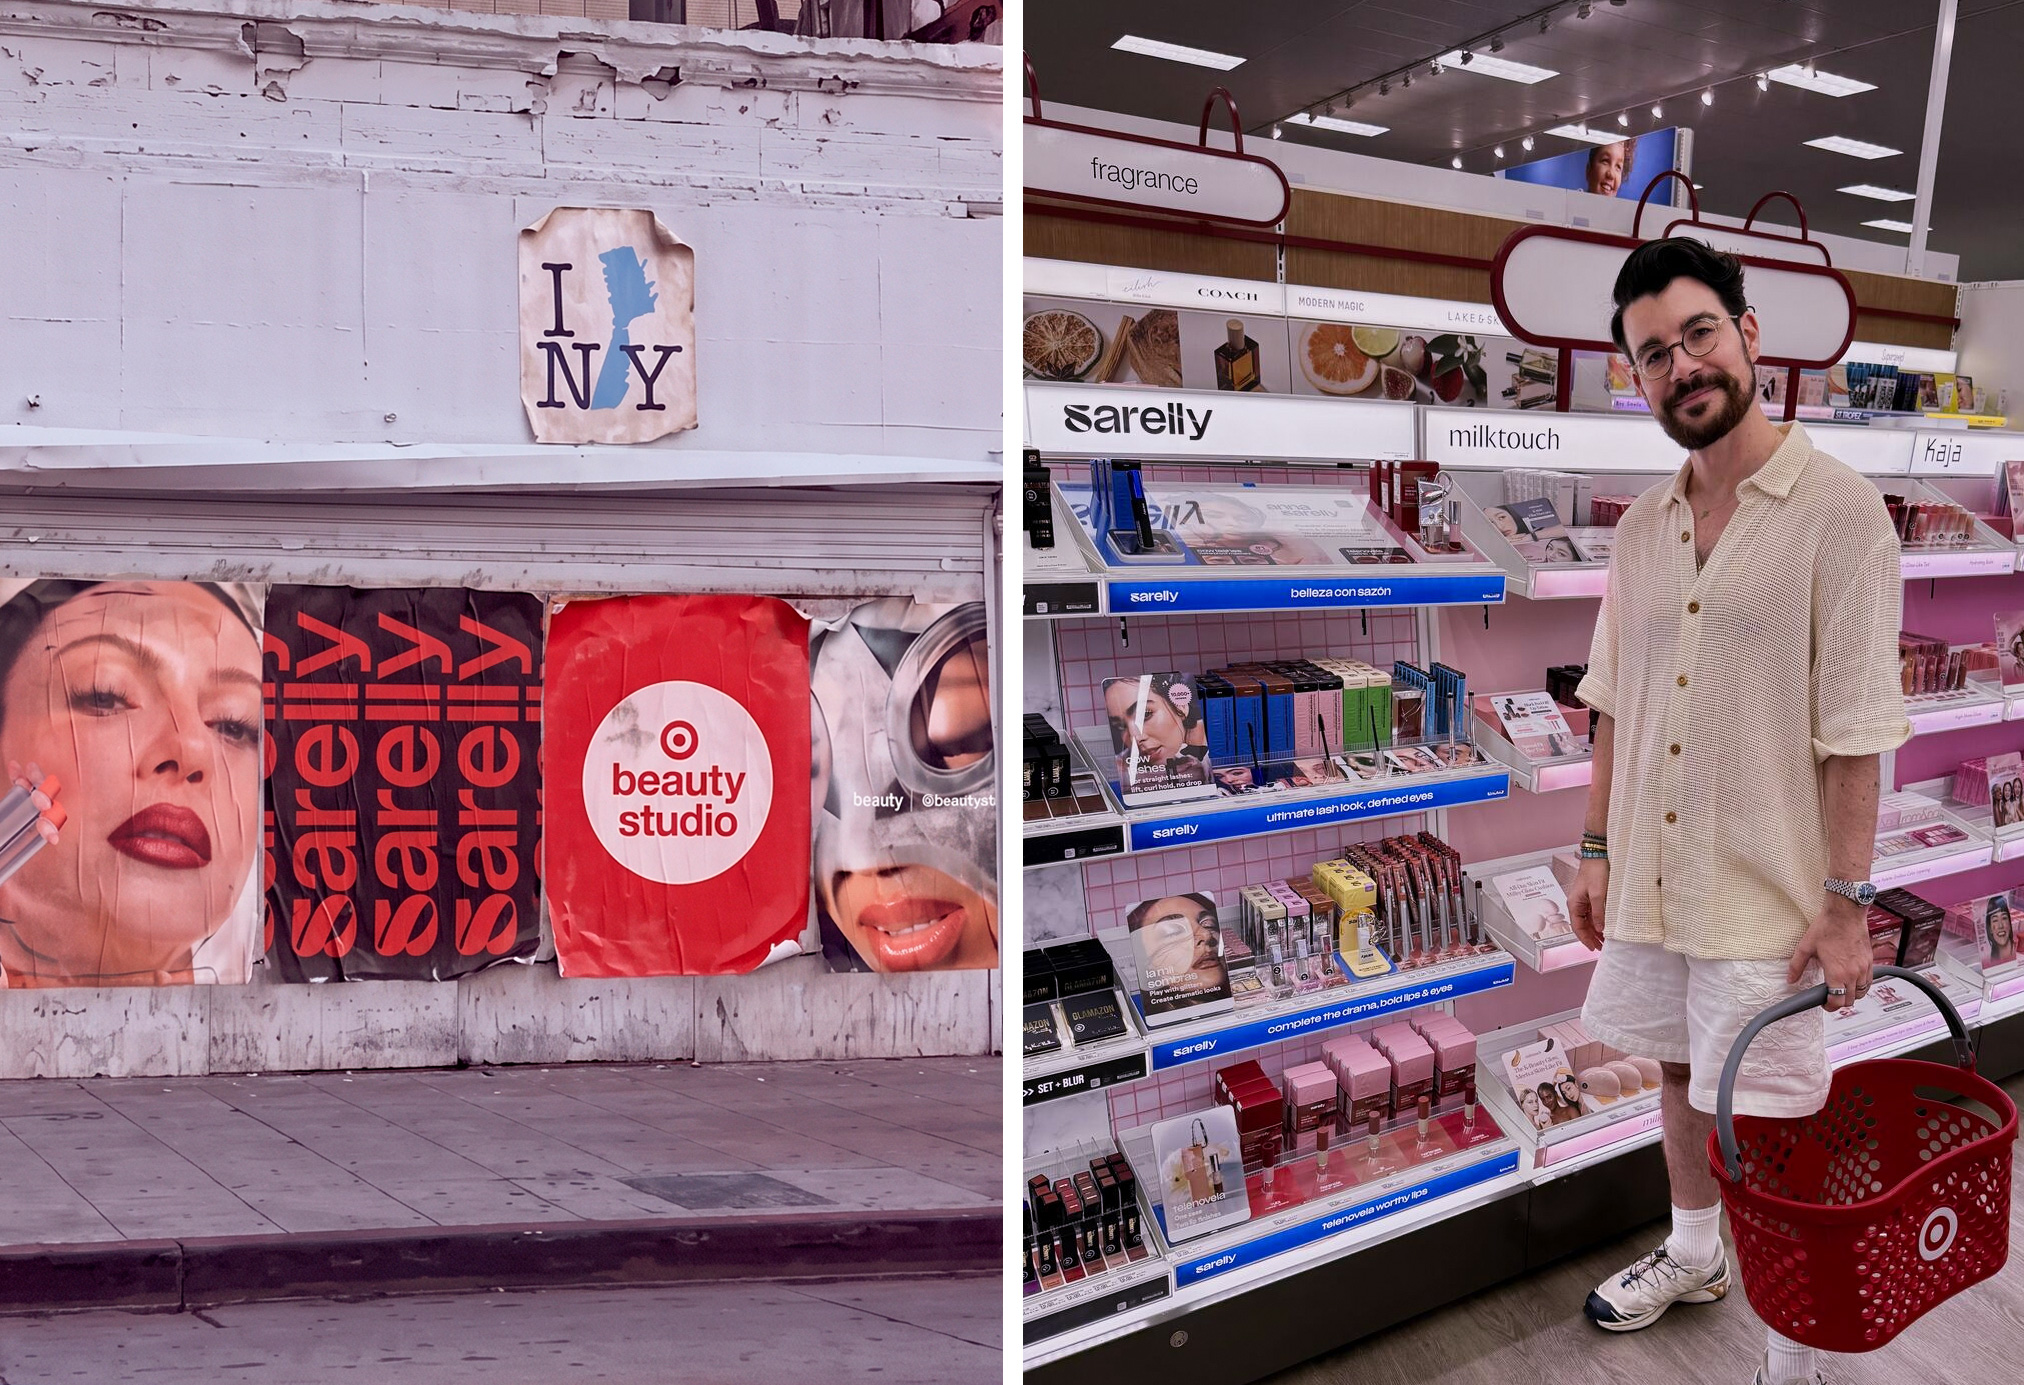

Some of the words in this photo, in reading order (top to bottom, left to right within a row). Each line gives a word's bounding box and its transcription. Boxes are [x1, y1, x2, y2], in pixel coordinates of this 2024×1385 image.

[1090, 157, 1198, 194] fragrance
[541, 262, 575, 338] I
[1197, 288, 1258, 301] COACH
[1298, 297, 1335, 309] MODERN
[1337, 300, 1365, 311] MAGIC
[1447, 312, 1475, 323] LAKE
[1487, 316, 1499, 325] SK
[1064, 402, 1213, 441] sarelly
[1450, 424, 1560, 450] milktouch
[1924, 438, 1962, 467] Kaja
[1130, 590, 1179, 603] sarelly
[1290, 588, 1332, 598] belleza
[1334, 588, 1356, 597] con
[1357, 586, 1392, 597] sazón
[283, 611, 372, 958] sarelly
[365, 611, 453, 957] sarelly
[446, 614, 532, 956] sarelly
[612, 762, 746, 804] beauty
[1142, 775, 1169, 783] straight
[1170, 773, 1193, 781] lashes:
[853, 792, 904, 811] beauty
[1266, 808, 1315, 822] ultimate
[1316, 805, 1339, 816] lash
[1340, 801, 1366, 812] look,
[1367, 794, 1409, 808] defined
[1409, 792, 1434, 803] eyes
[618, 803, 738, 837] studio
[1152, 824, 1199, 839] sarelly
[1145, 970, 1156, 979] la
[1148, 972, 1198, 988] sombras
[1149, 989, 1163, 997] Play
[1164, 986, 1179, 994] with
[1151, 995, 1173, 1005] Create
[1174, 990, 1203, 1000] dramatic
[1204, 986, 1221, 994] looks
[1072, 1004, 1115, 1021] GLAMAZON
[1267, 1014, 1322, 1034] complete
[1322, 1009, 1341, 1021] the
[1342, 1001, 1379, 1016] drama,
[1380, 994, 1403, 1007] bold
[1404, 991, 1421, 1003] lips
[1421, 989, 1429, 997] &
[1430, 983, 1453, 995] eyes
[1173, 1040, 1217, 1057] sarelly
[1037, 1081, 1054, 1094] SET
[1062, 1074, 1085, 1088] BLUR
[1642, 1113, 1664, 1127] milk
[1172, 1192, 1226, 1213] telenovela
[1322, 1206, 1375, 1230] telenovela
[1376, 1193, 1411, 1211] worthy
[1411, 1188, 1428, 1200] lips
[1195, 1253, 1237, 1274] sarelly
